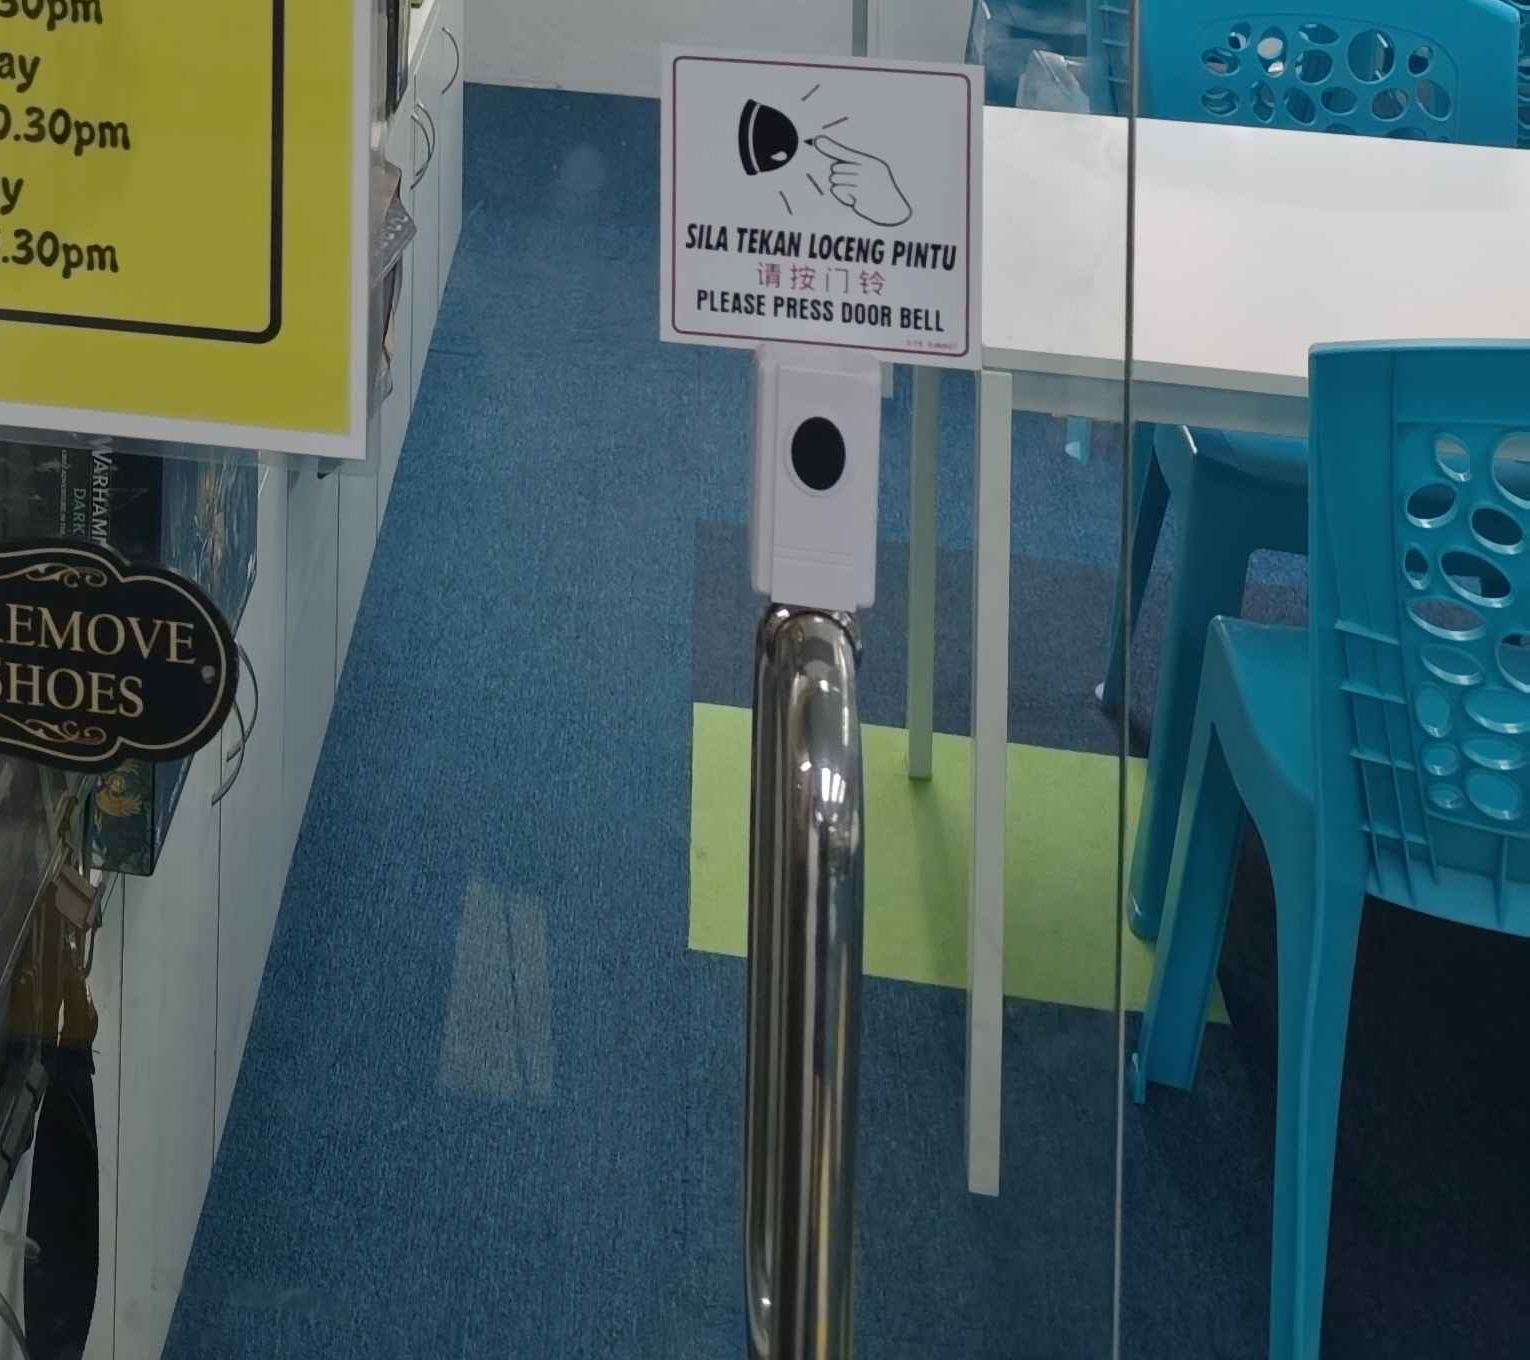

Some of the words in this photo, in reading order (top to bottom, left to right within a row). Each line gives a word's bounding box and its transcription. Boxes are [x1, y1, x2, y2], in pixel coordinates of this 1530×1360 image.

[685, 223, 729, 253] SILA
[736, 226, 802, 258] TEKAN
[807, 232, 886, 265] LOCENG
[891, 239, 958, 272] PINTU
[757, 261, 887, 296] 请按门铃
[697, 290, 767, 318] PLEASE
[773, 296, 834, 323] PRESS
[841, 302, 892, 329] DOOR
[899, 306, 945, 333] BELL
